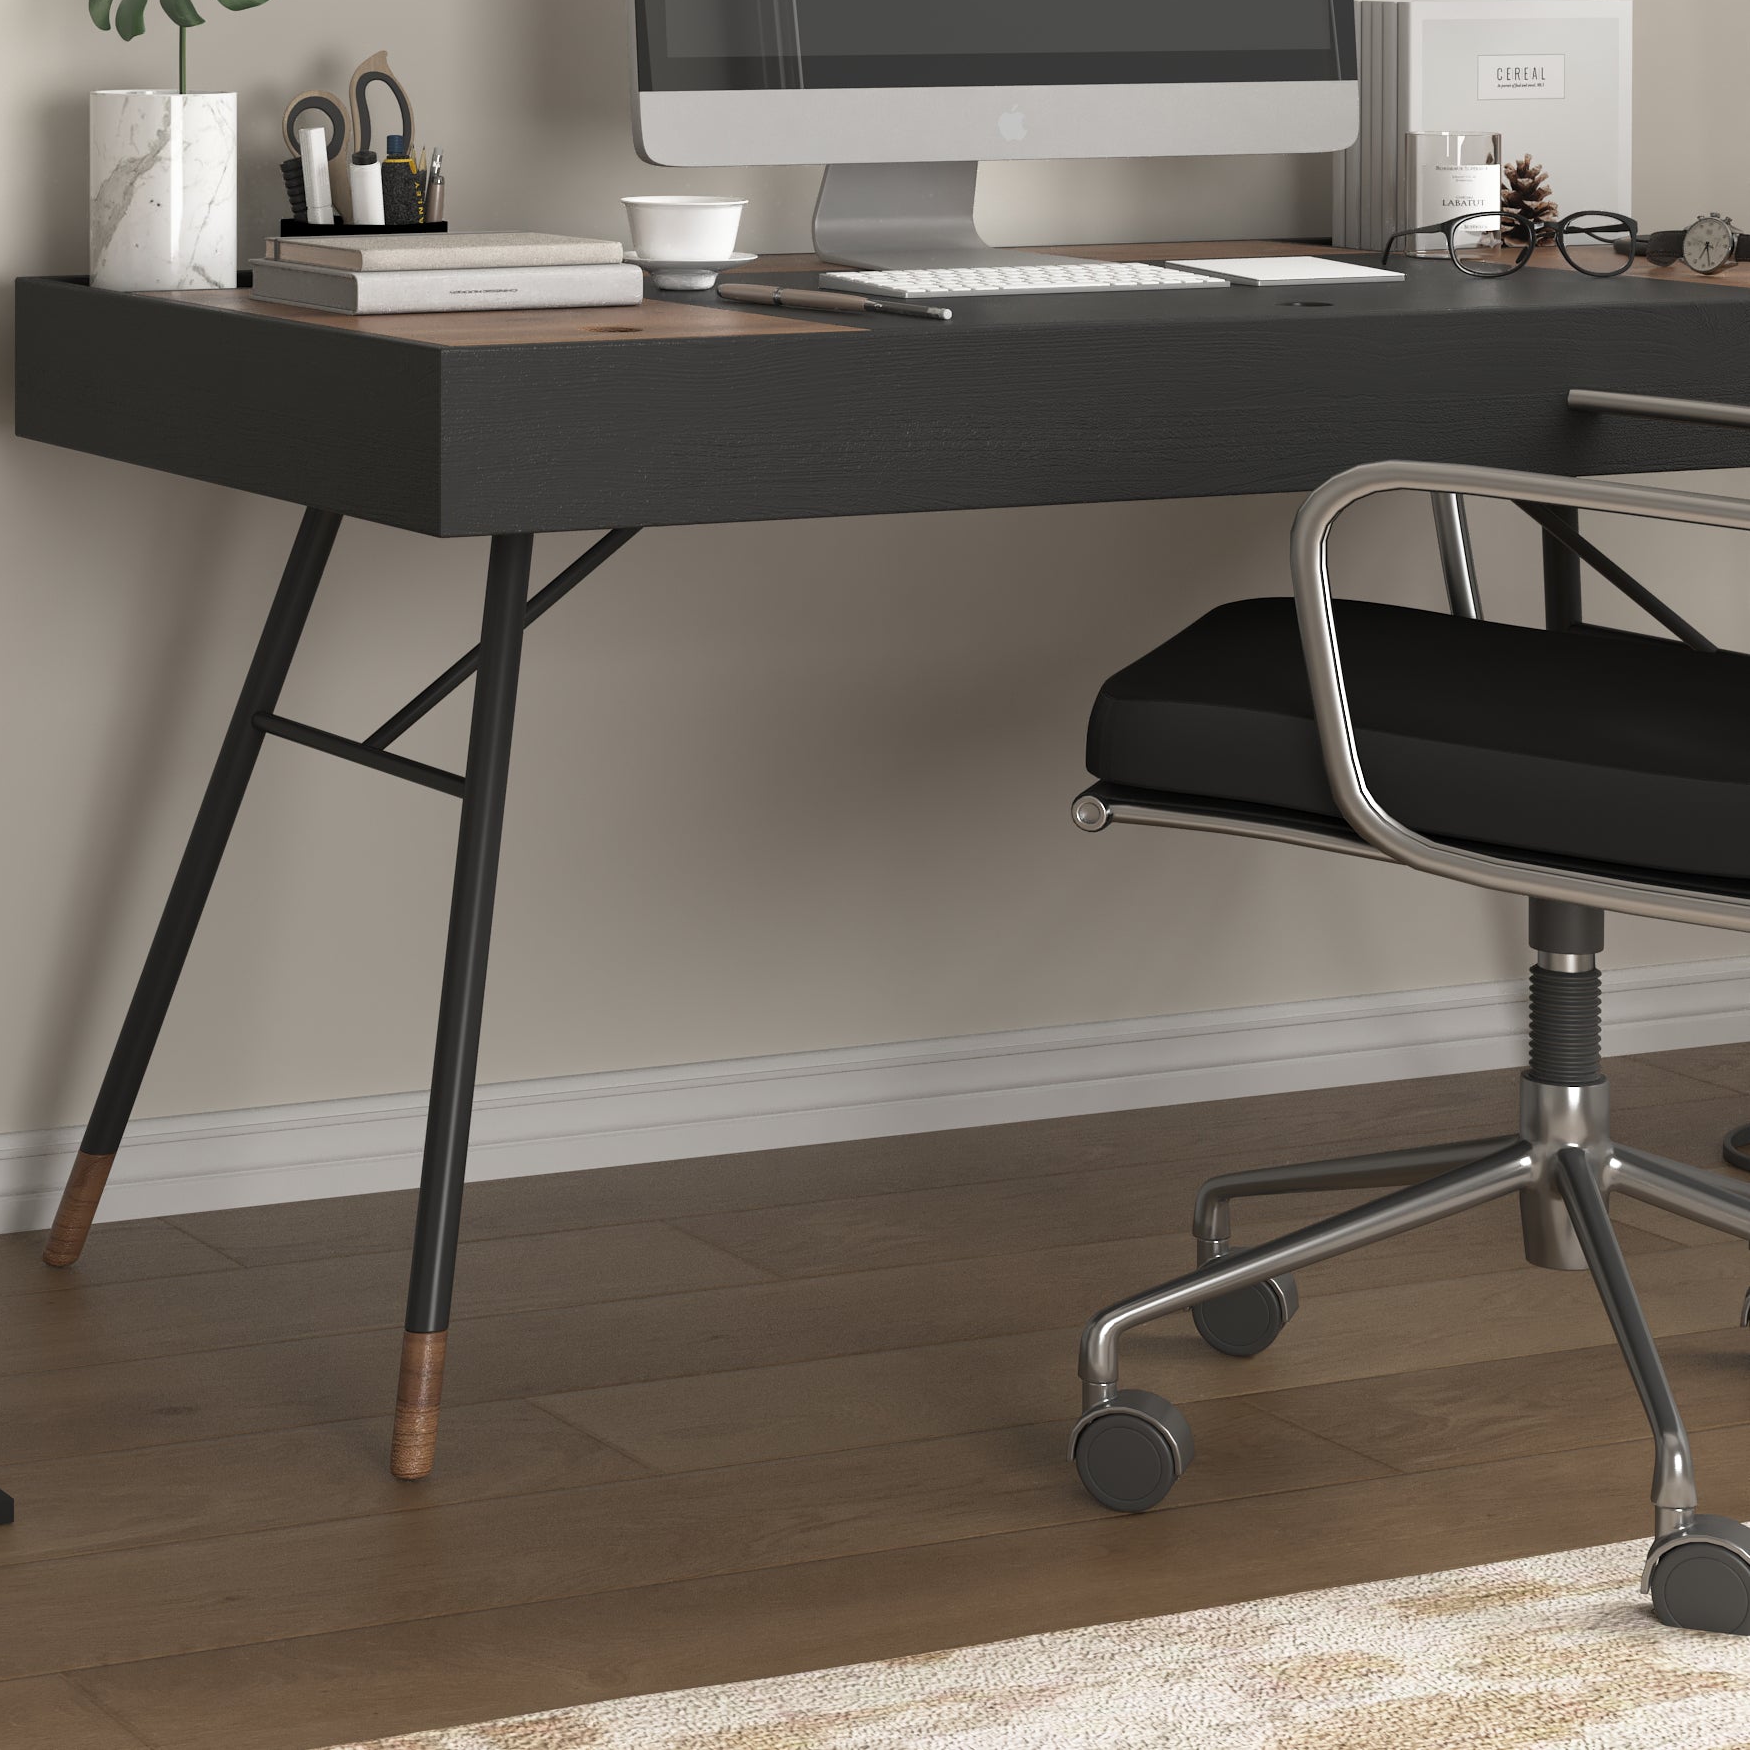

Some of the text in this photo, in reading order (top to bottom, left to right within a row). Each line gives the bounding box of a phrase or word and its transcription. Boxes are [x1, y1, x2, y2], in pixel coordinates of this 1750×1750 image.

[1496, 66, 1546, 81] CEREAL
[414, 181, 425, 224] ANLEY
[1442, 199, 1486, 207] LABATUT
